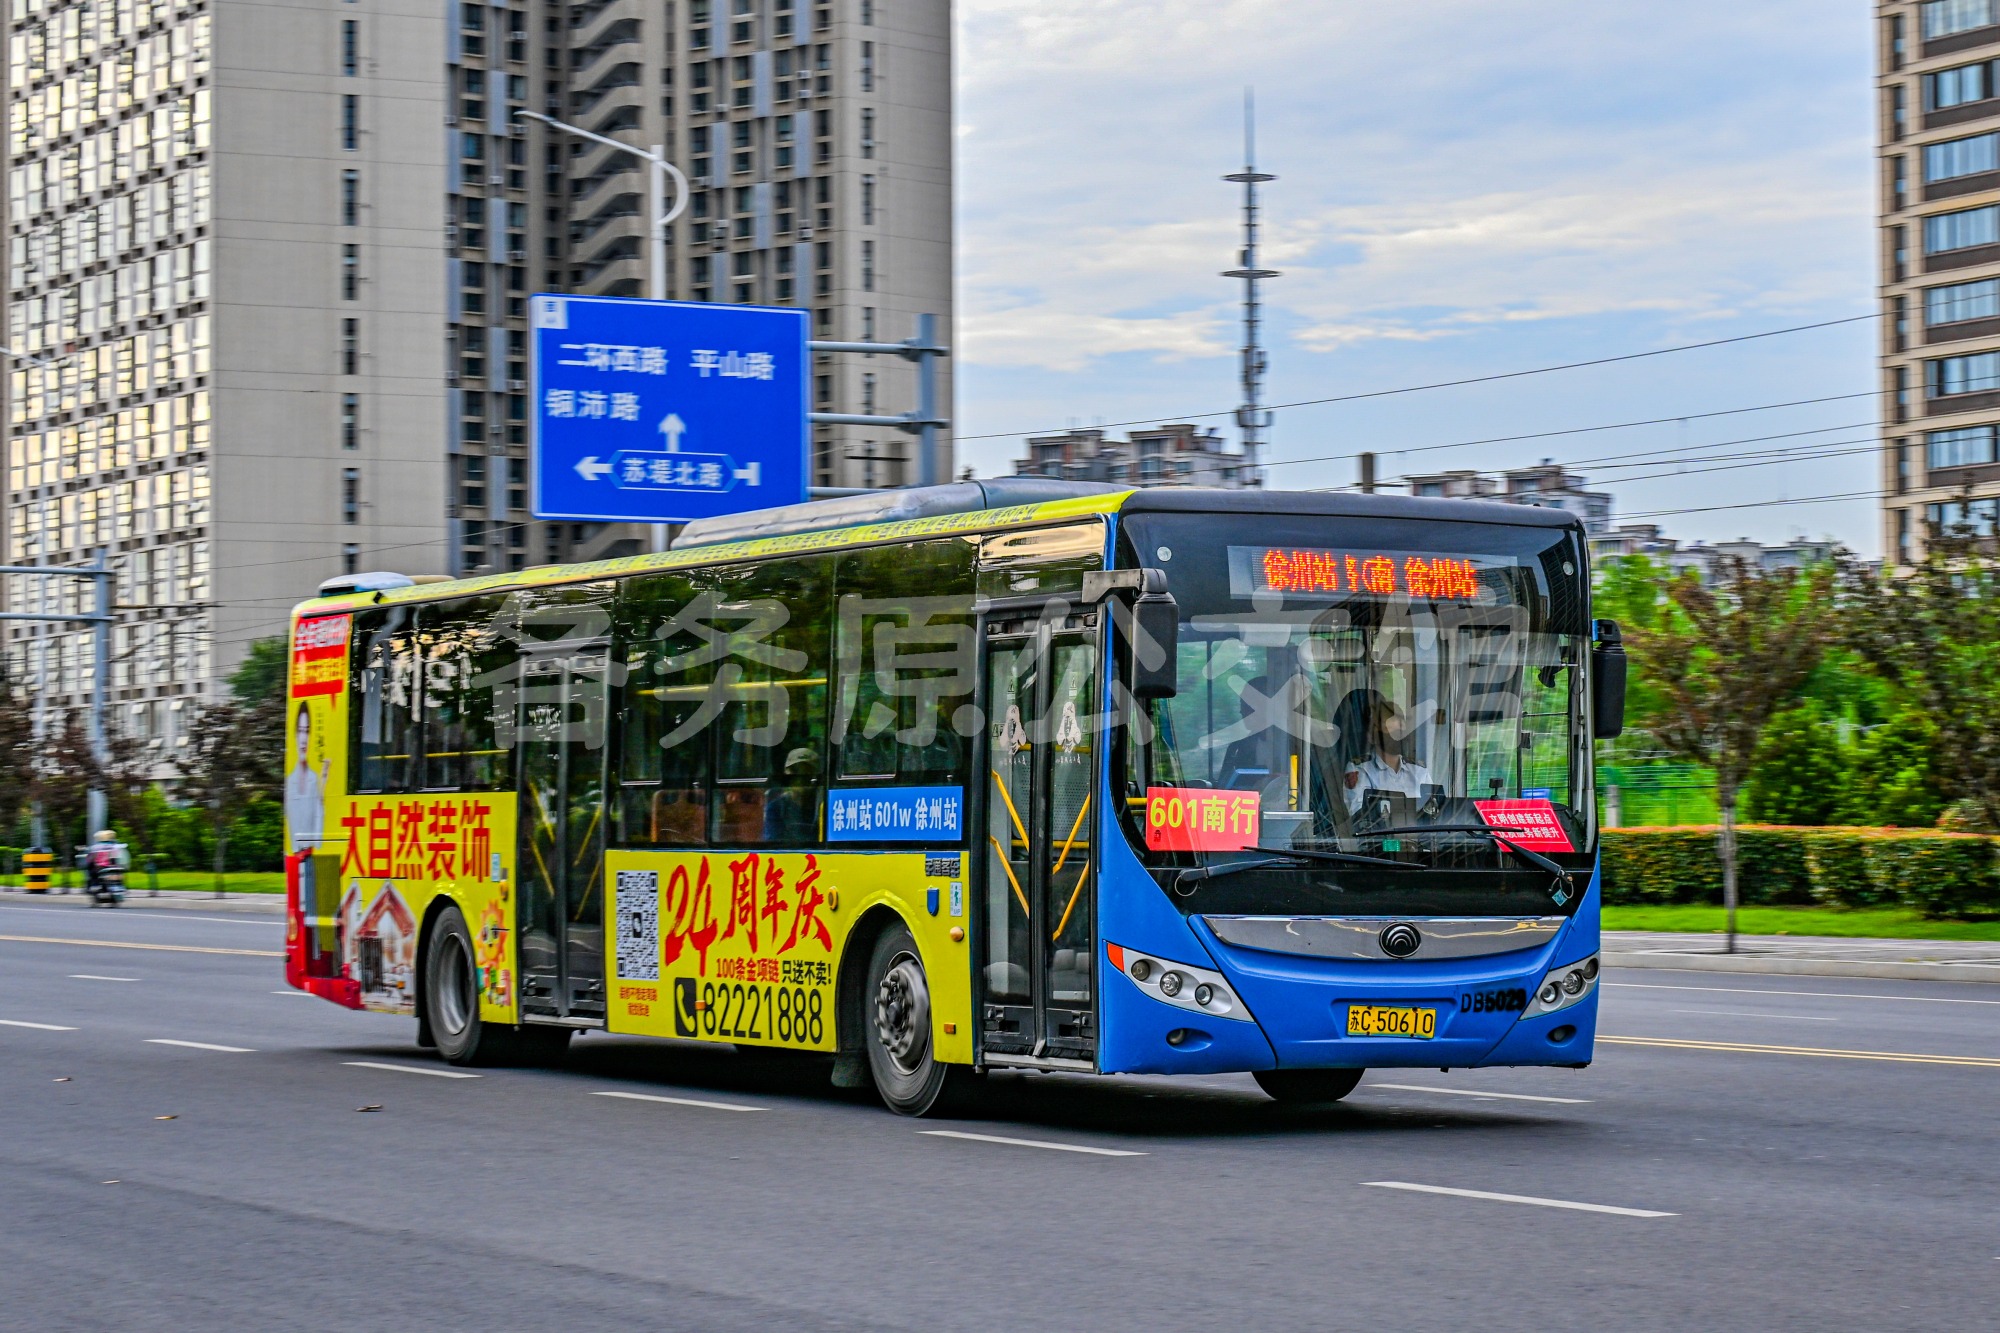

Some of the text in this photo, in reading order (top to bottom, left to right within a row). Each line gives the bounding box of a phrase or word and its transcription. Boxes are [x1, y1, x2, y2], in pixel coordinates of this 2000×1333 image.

[690, 349, 776, 381] 平山路
[1263, 550, 1339, 593] 徐州站
[1404, 556, 1477, 599] 徐州站
[832, 796, 957, 833] 徐州站 601w 徐州站
[1150, 795, 1257, 835] 601南行
[1488, 812, 1554, 825] 文明创建新起点
[341, 800, 491, 884] 大自然装饰
[665, 852, 833, 977] 24周年庆
[716, 957, 780, 984] 100条金项链
[703, 981, 823, 1045] 82221888
